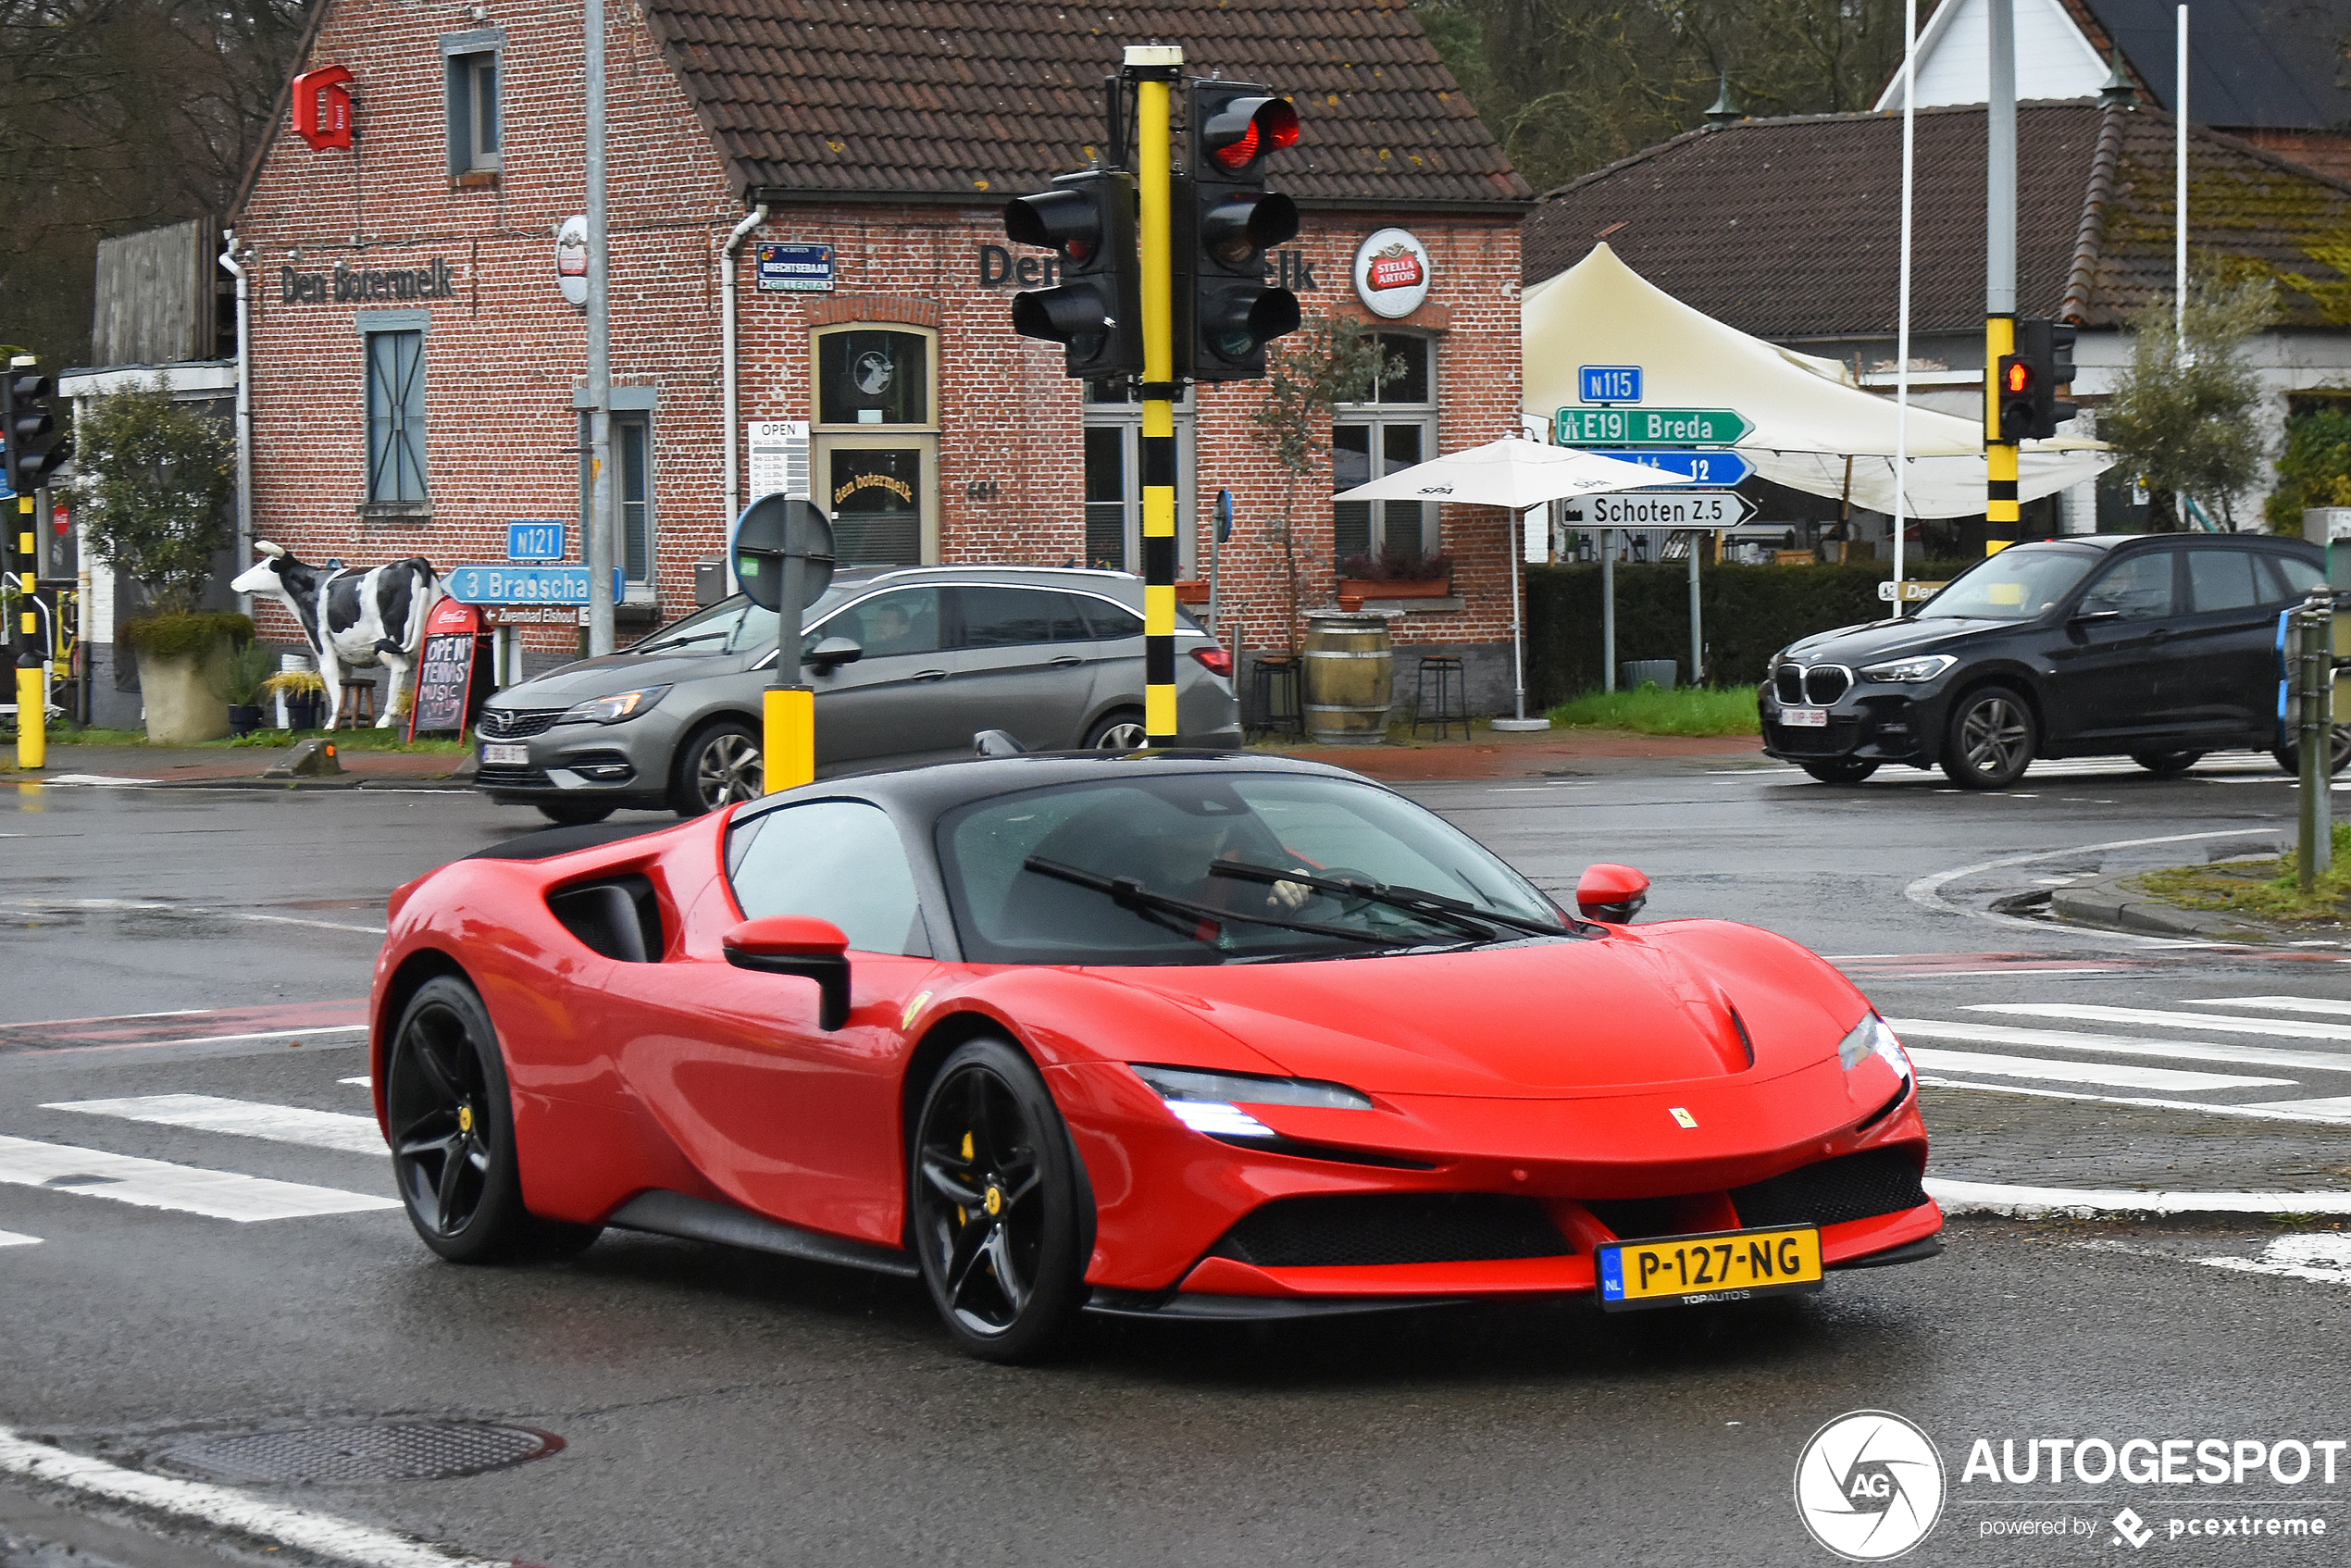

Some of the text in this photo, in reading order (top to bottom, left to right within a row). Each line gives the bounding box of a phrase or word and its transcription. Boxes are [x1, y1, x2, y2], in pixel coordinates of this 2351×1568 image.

[763, 262, 829, 274] BRECHTSEBAAN
[1377, 260, 1415, 274] STELLA
[281, 257, 455, 304] Den Botermelk
[768, 280, 824, 290] GILLENIA
[1378, 270, 1416, 284] ARTOIS
[1590, 372, 1633, 397] N115
[761, 424, 796, 436] OPEN
[1584, 413, 1712, 439] E19 Breda
[1690, 459, 1710, 480] 12
[835, 471, 914, 504] den botermelk
[1417, 487, 1455, 495] SPA
[1574, 479, 1612, 490] SPA
[1594, 498, 1723, 522] Schoten Z.5
[517, 528, 554, 554] N121
[466, 571, 589, 600] 3 Brasscha
[498, 607, 577, 623] Zwembad Elshout
[427, 637, 466, 662] OPEN
[418, 684, 459, 702] MUSIC
[1638, 1237, 1801, 1290] P-127-NG
[1605, 1279, 1622, 1292] NL
[1682, 1289, 1751, 1305] TOPAUTO'S
